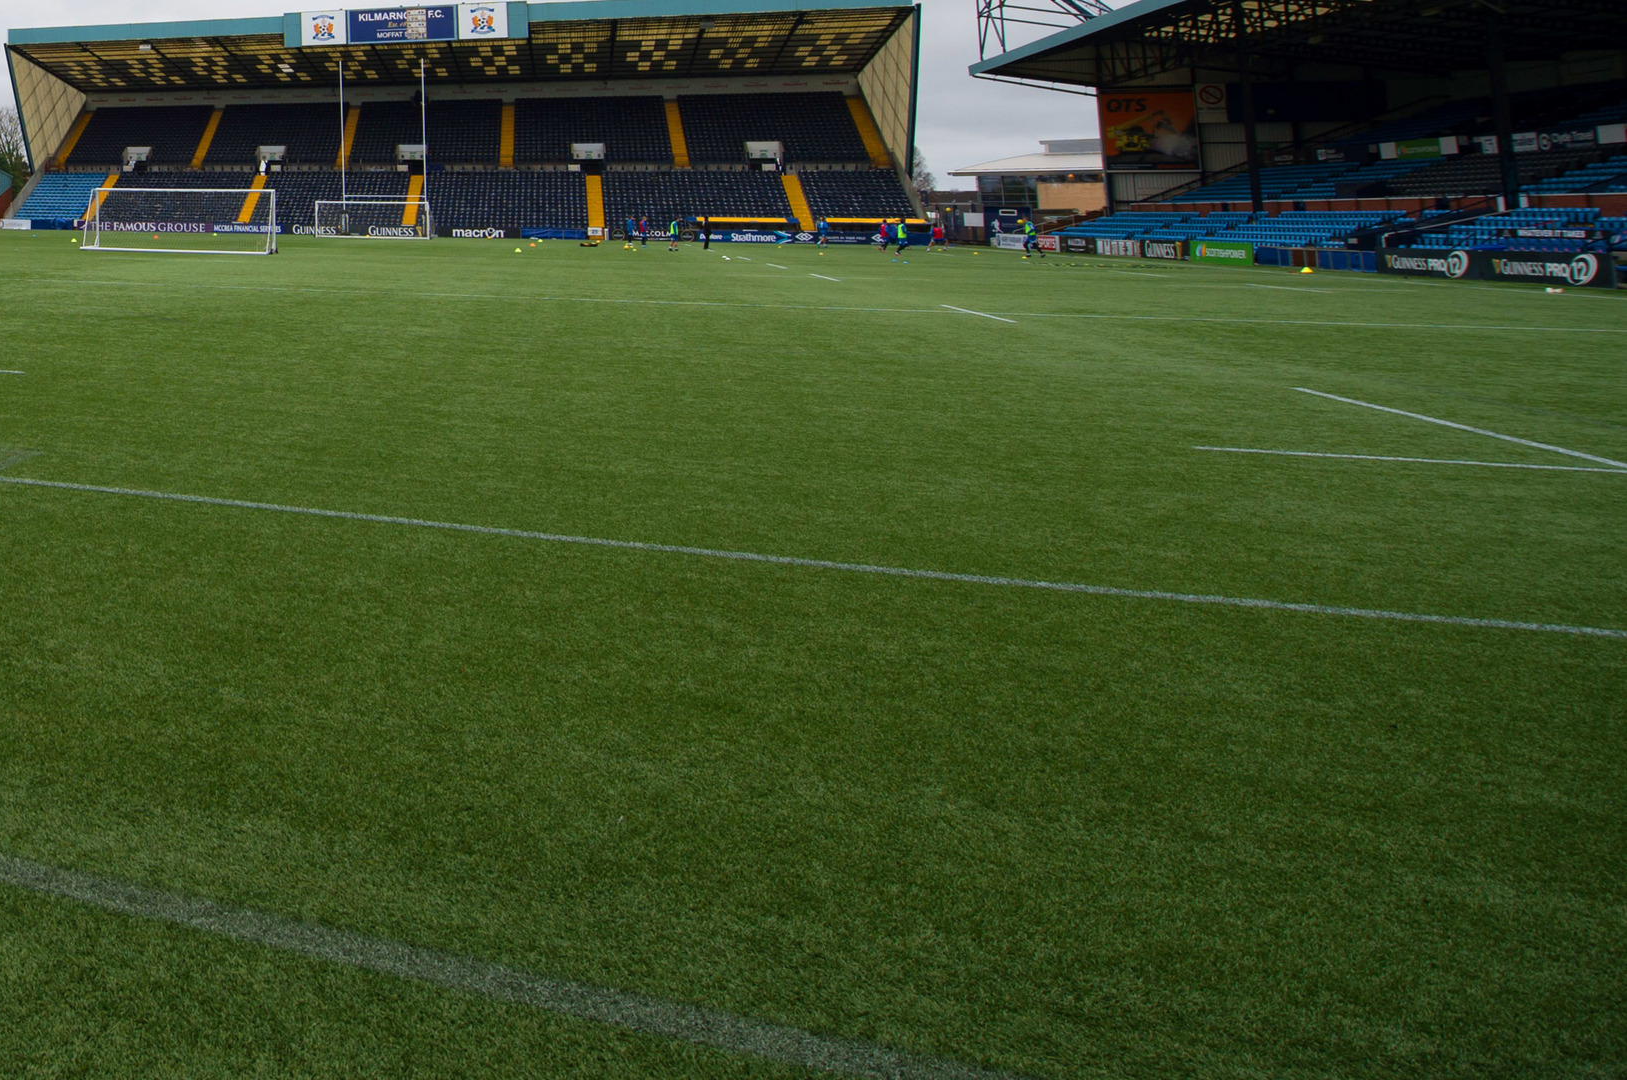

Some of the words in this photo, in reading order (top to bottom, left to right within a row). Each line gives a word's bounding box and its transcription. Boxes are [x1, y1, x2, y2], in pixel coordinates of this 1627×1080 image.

[428, 10, 445, 19] F.C.
[376, 31, 403, 39] MOFFAT
[1106, 98, 1147, 112] QTS
[90, 222, 110, 231] THE
[114, 222, 156, 232] FAMOUS
[158, 222, 206, 232] GROUSE
[292, 224, 337, 235] GUINNESS
[368, 226, 414, 236] GUINNESS
[452, 227, 504, 238] macron
[731, 232, 776, 242] Strathmore
[1517, 229, 1554, 238] WHATEVER
[1562, 230, 1586, 238] TAKES
[1145, 240, 1175, 258] GUINNESS
[1206, 248, 1246, 258] SCOTTISHPOWER
[1391, 254, 1426, 270] GUINNESS
[1427, 256, 1461, 272] PRO12
[1500, 258, 1544, 276] GUINNESS
[1546, 262, 1587, 280] PRO12
